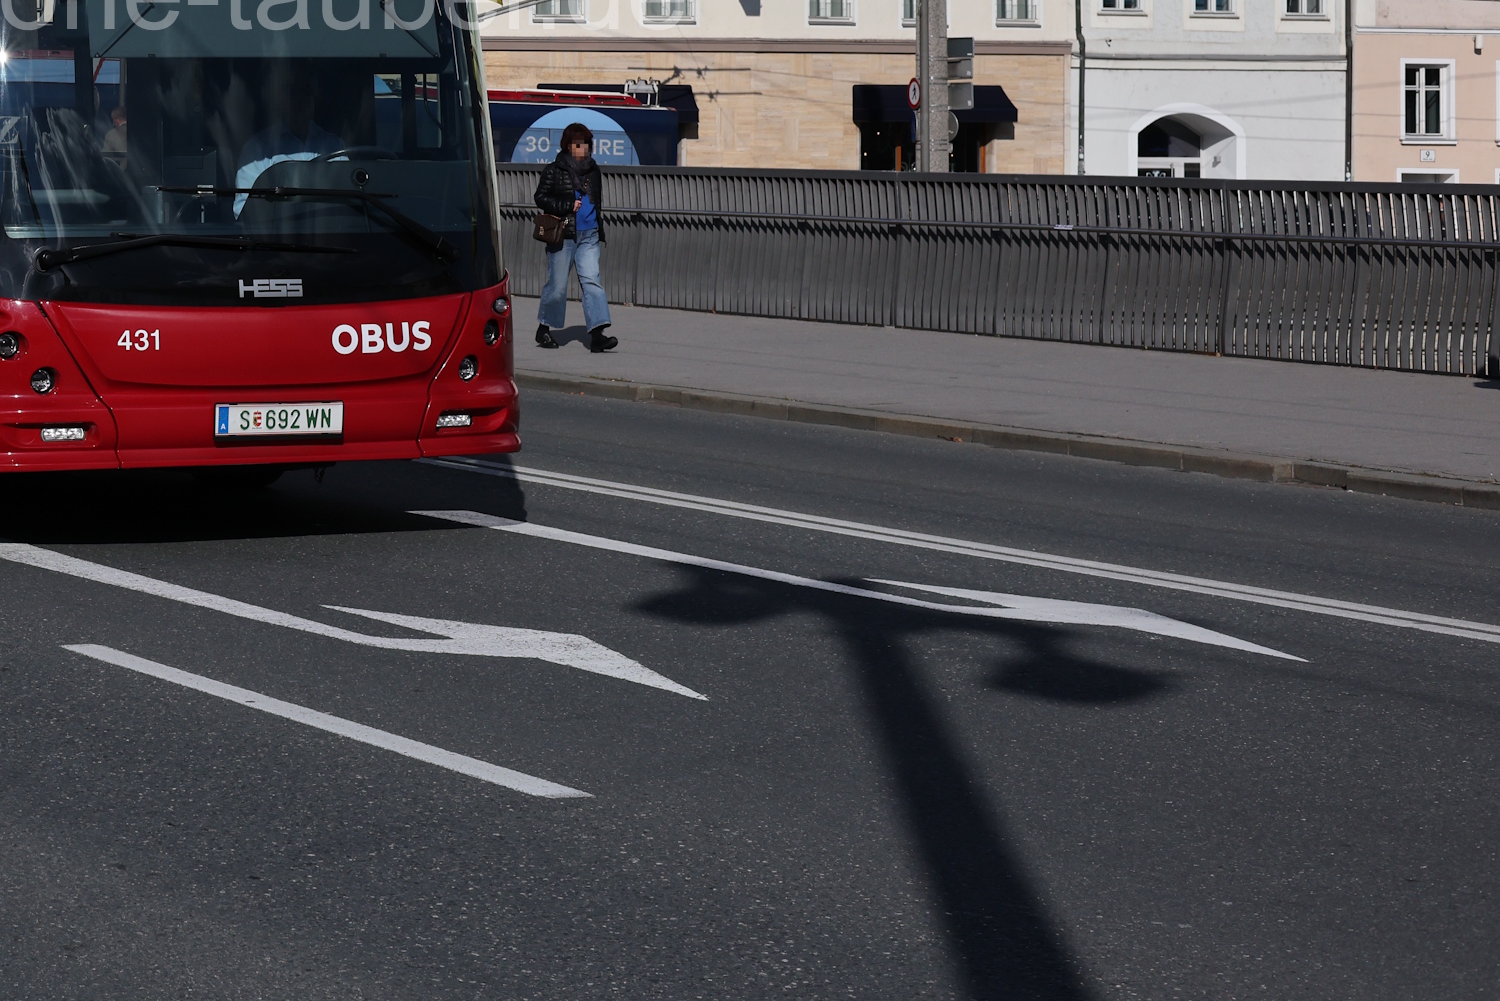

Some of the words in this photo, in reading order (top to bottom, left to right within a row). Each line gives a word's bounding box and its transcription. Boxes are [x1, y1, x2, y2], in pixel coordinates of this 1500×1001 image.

[526, 135, 550, 152] 30
[238, 278, 303, 298] HESS
[117, 329, 161, 351] 431
[331, 320, 433, 355] OBUS
[240, 410, 250, 431] S
[266, 408, 301, 430] 692
[306, 408, 332, 429] WN
